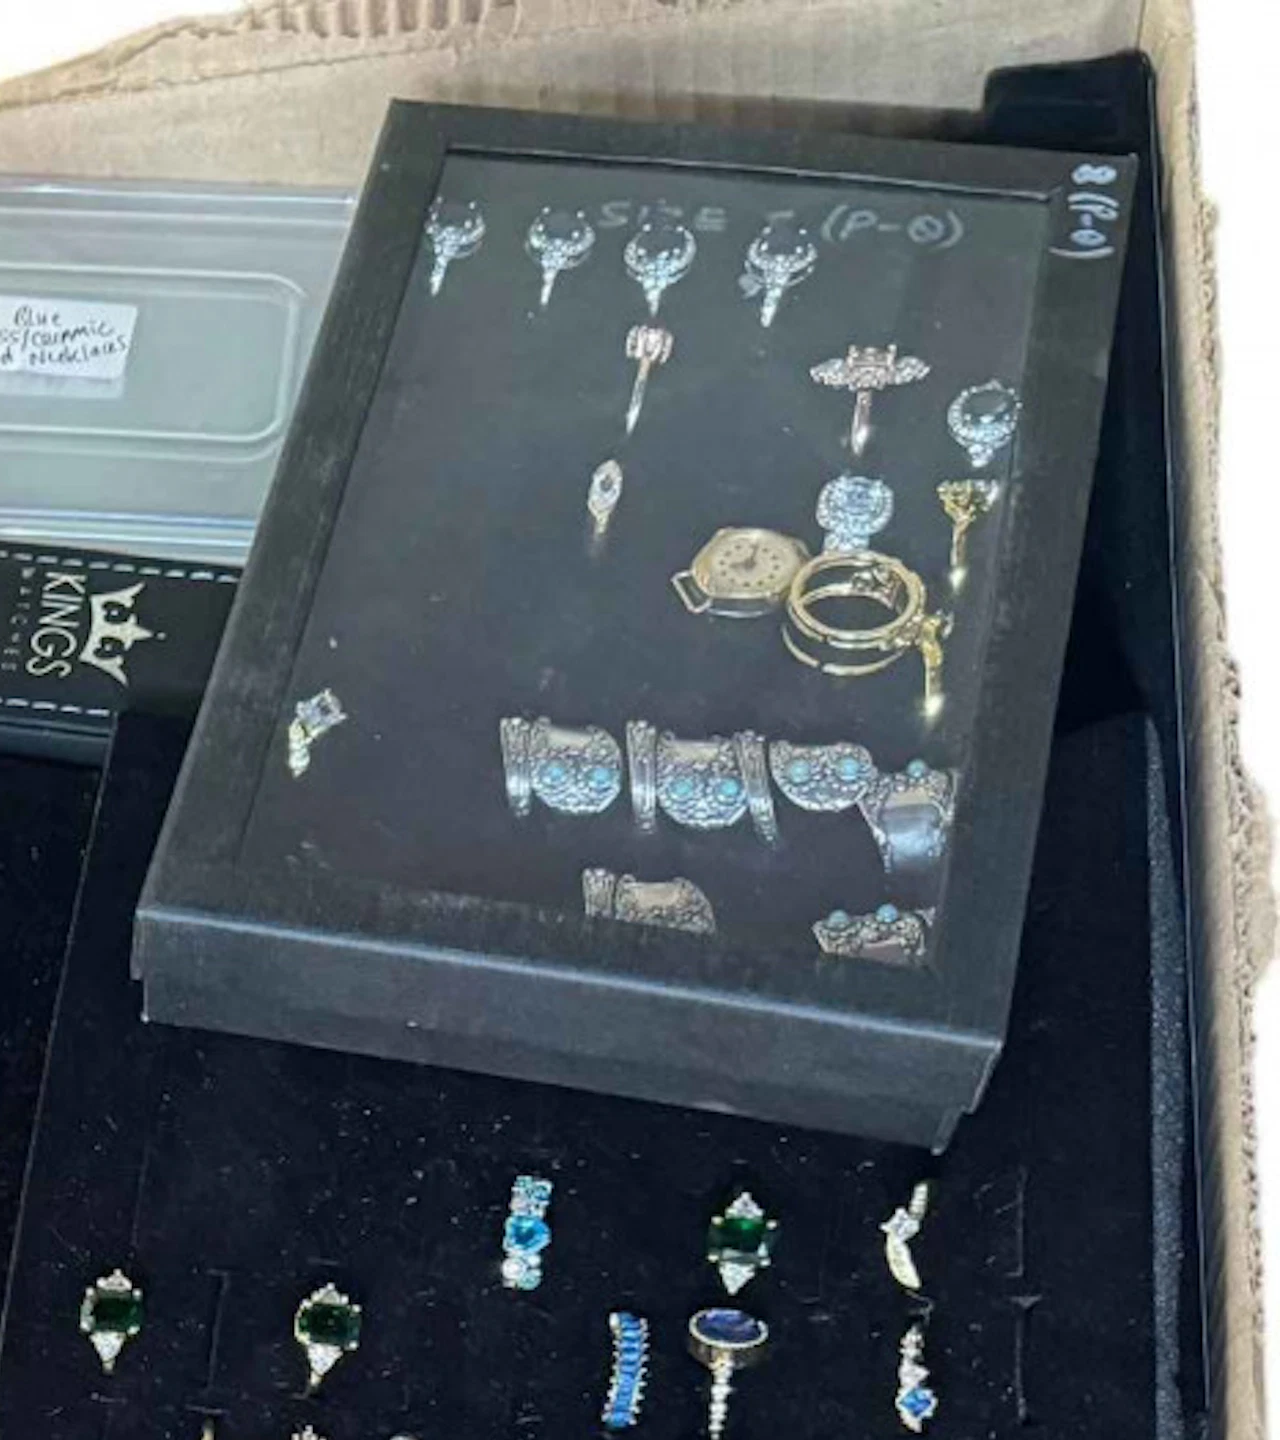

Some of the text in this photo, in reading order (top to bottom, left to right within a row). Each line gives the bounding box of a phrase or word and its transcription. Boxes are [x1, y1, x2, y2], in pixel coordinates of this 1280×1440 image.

[1070, 163, 1118, 185] 8
[596, 200, 728, 233] SIE
[24, 571, 88, 679] KINGS
